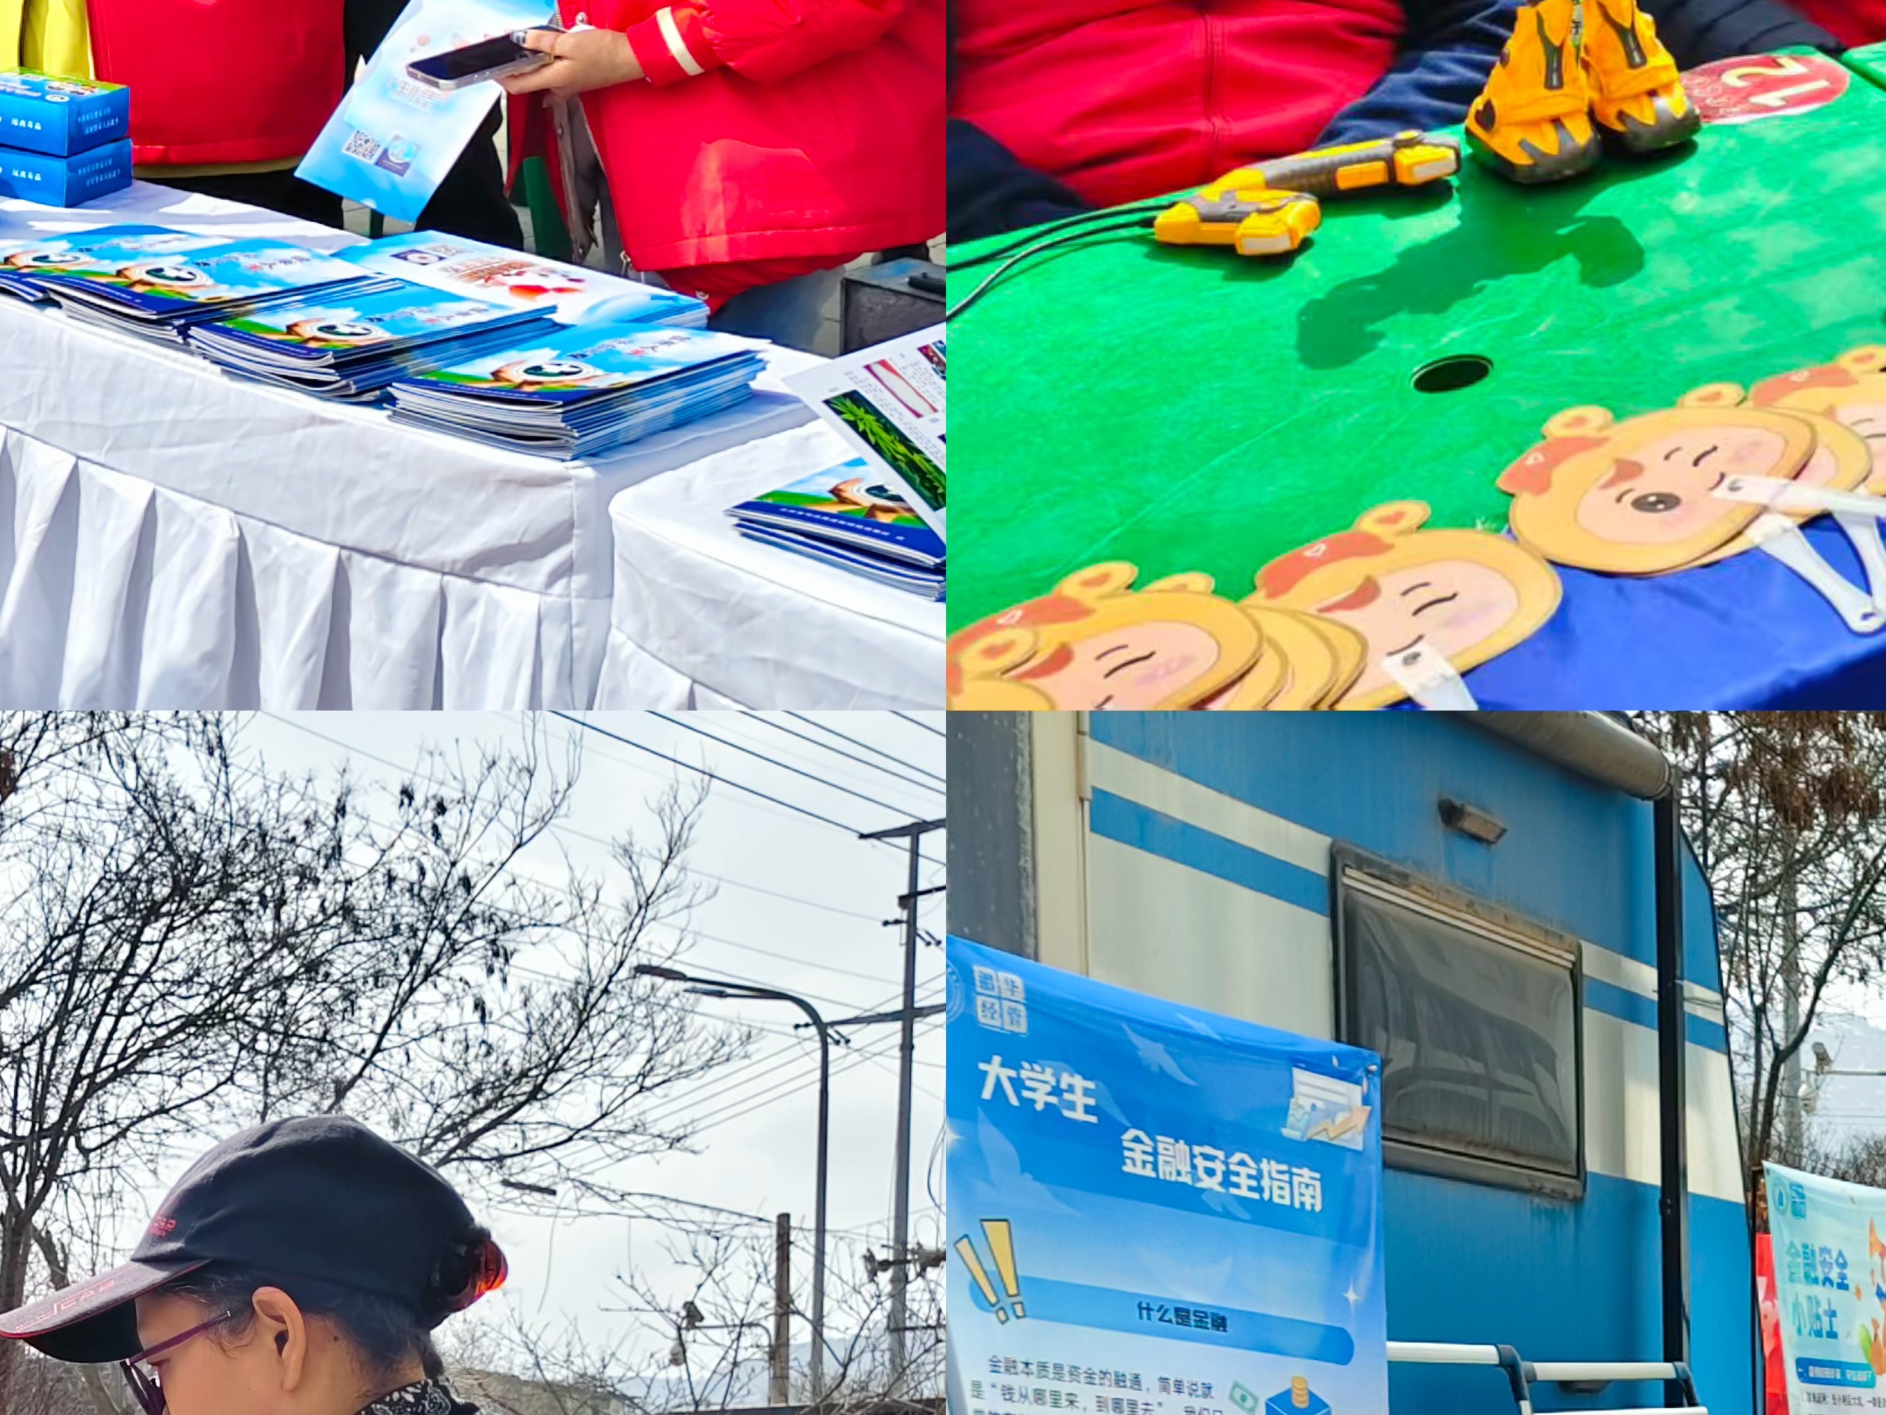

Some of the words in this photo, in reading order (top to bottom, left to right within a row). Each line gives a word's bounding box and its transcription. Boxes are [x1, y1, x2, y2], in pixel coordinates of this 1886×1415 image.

[977, 1055, 1099, 1126] 大学生
[1121, 1126, 1323, 1215] 金融安全指南
[1137, 1300, 1229, 1334] 什么是金融
